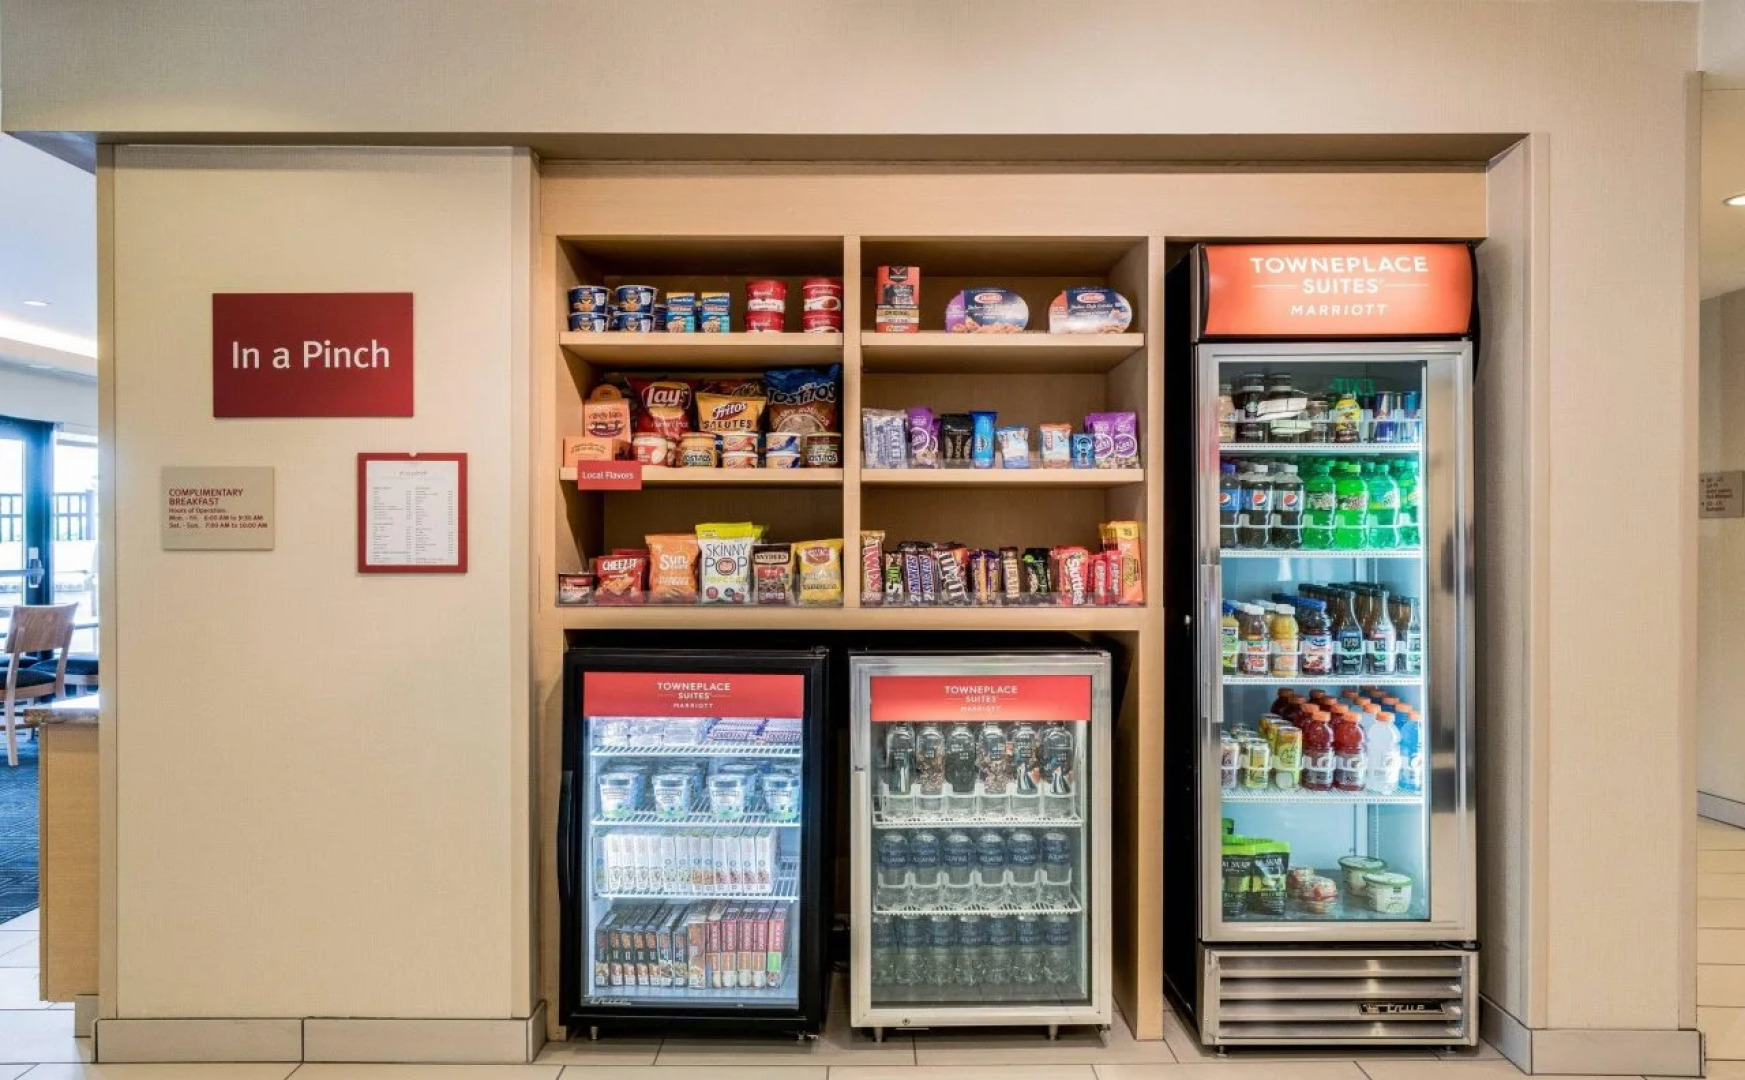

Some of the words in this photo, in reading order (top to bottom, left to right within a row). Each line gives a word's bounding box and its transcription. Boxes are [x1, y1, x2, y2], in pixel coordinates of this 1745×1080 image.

[1249, 256, 1429, 274] TOWNEPLACE
[1302, 278, 1379, 294] SUITES
[1290, 303, 1389, 316] MARRIOTT
[231, 341, 261, 369] In
[272, 346, 290, 369] a
[303, 339, 390, 369] Pinch
[646, 386, 689, 409] Lay's
[714, 402, 748, 419] Fritos
[704, 419, 752, 429] SALUTES
[582, 471, 603, 480] Local
[605, 471, 634, 480] Flavors
[168, 488, 244, 497] COMPLIMENTARY
[168, 498, 219, 506] BREAKFAST
[705, 543, 748, 557] SKINNY
[704, 557, 748, 576] POP
[1003, 558, 1020, 599] HEATH
[656, 682, 732, 691] TOWNEPLACE
[944, 685, 1018, 694] TOWNEPLACE
[678, 692, 710, 700] SUITES
[965, 695, 997, 703] SUITES
